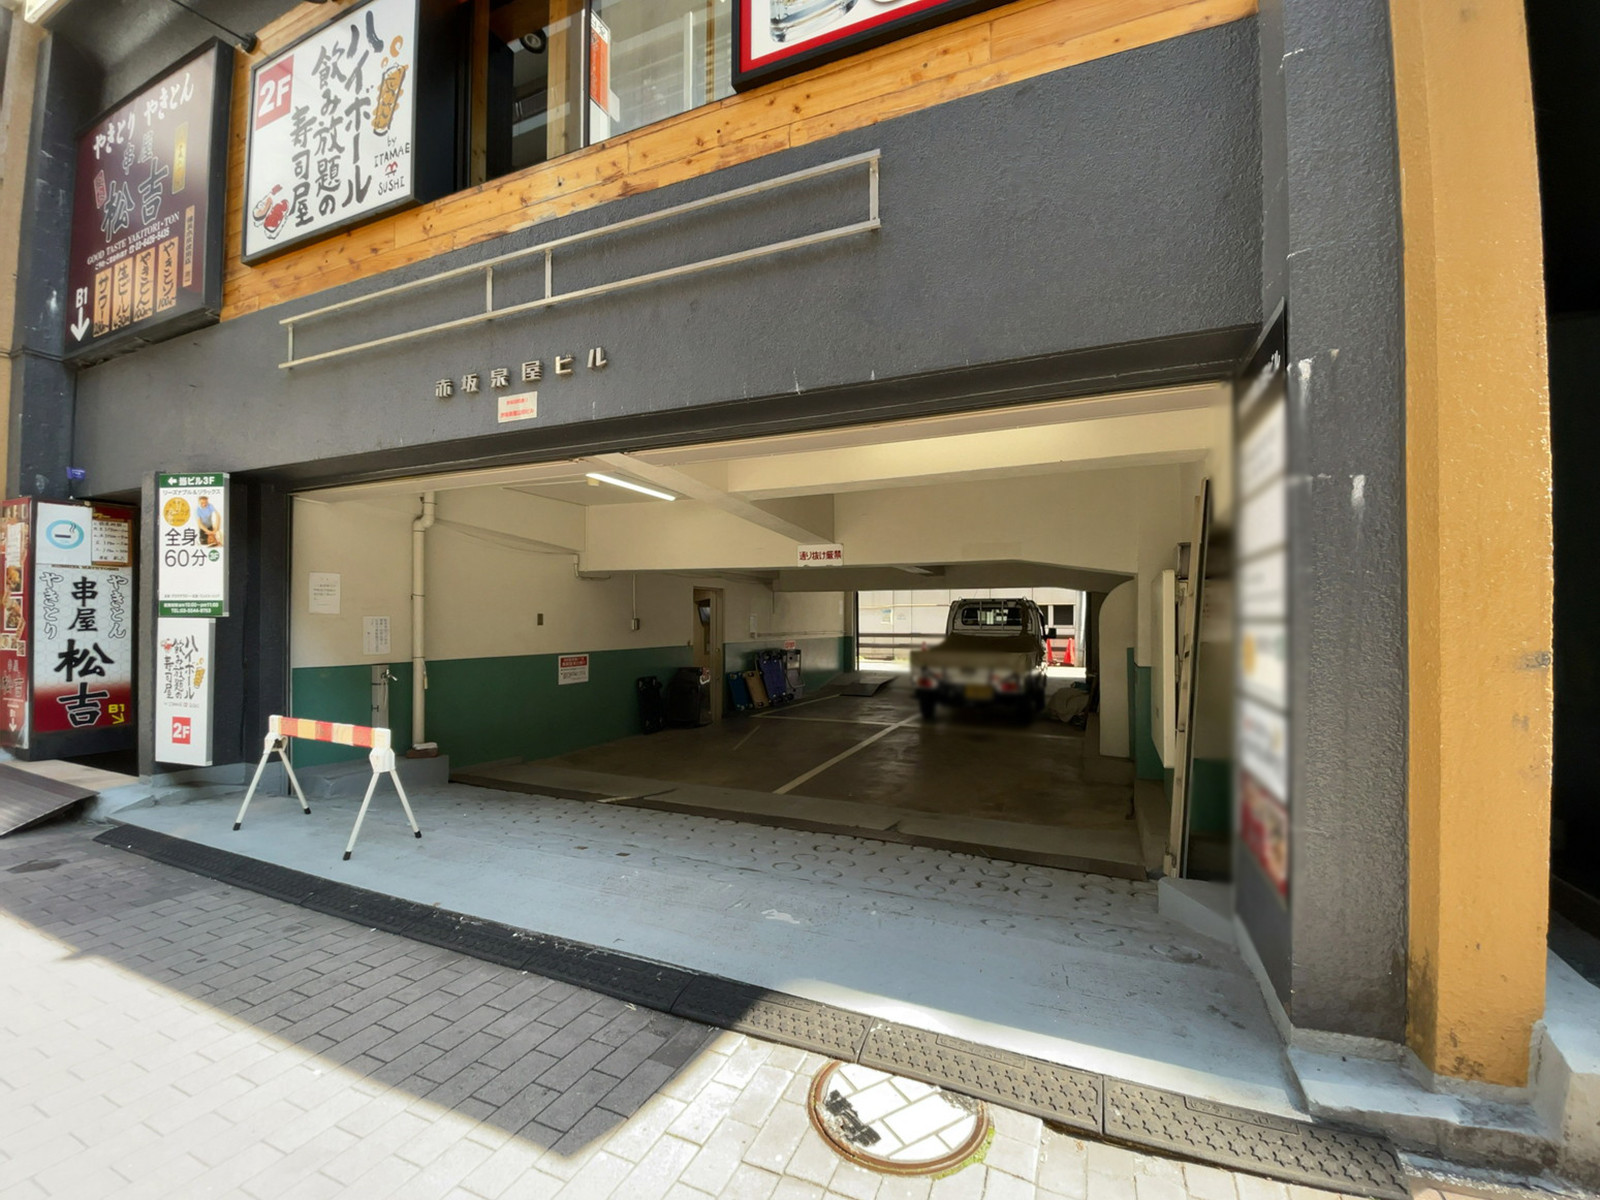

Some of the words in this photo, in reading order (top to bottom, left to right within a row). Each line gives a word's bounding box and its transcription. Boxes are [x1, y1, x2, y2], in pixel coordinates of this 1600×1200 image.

[258, 74, 291, 118] 2F
[342, 10, 384, 204] ハイボール
[93, 111, 135, 159] やきとり
[144, 72, 194, 126] やきとん
[312, 40, 346, 216] 飲み放題の
[387, 136, 397, 147] by
[288, 105, 318, 228] 寿司屋
[374, 142, 411, 168] ITAMAE
[101, 156, 169, 242] 松吉
[377, 181, 406, 196] SUSHI
[87, 249, 105, 265] GOOD
[106, 238, 127, 254] TASTE
[76, 287, 88, 308] B1
[435, 347, 608, 398] 赤坂泉屋ビル
[179, 476, 215, 486] 当ビル3F
[165, 528, 197, 547] 全身
[165, 549, 207, 567] 60分
[209, 552, 219, 560] 3F
[799, 550, 841, 560] 通り抜け厳禁
[39, 572, 64, 639] やきとり
[107, 574, 128, 639] やきとん
[184, 635, 198, 700] ハイボール
[108, 704, 125, 713] B1
[172, 722, 190, 740] 2F
